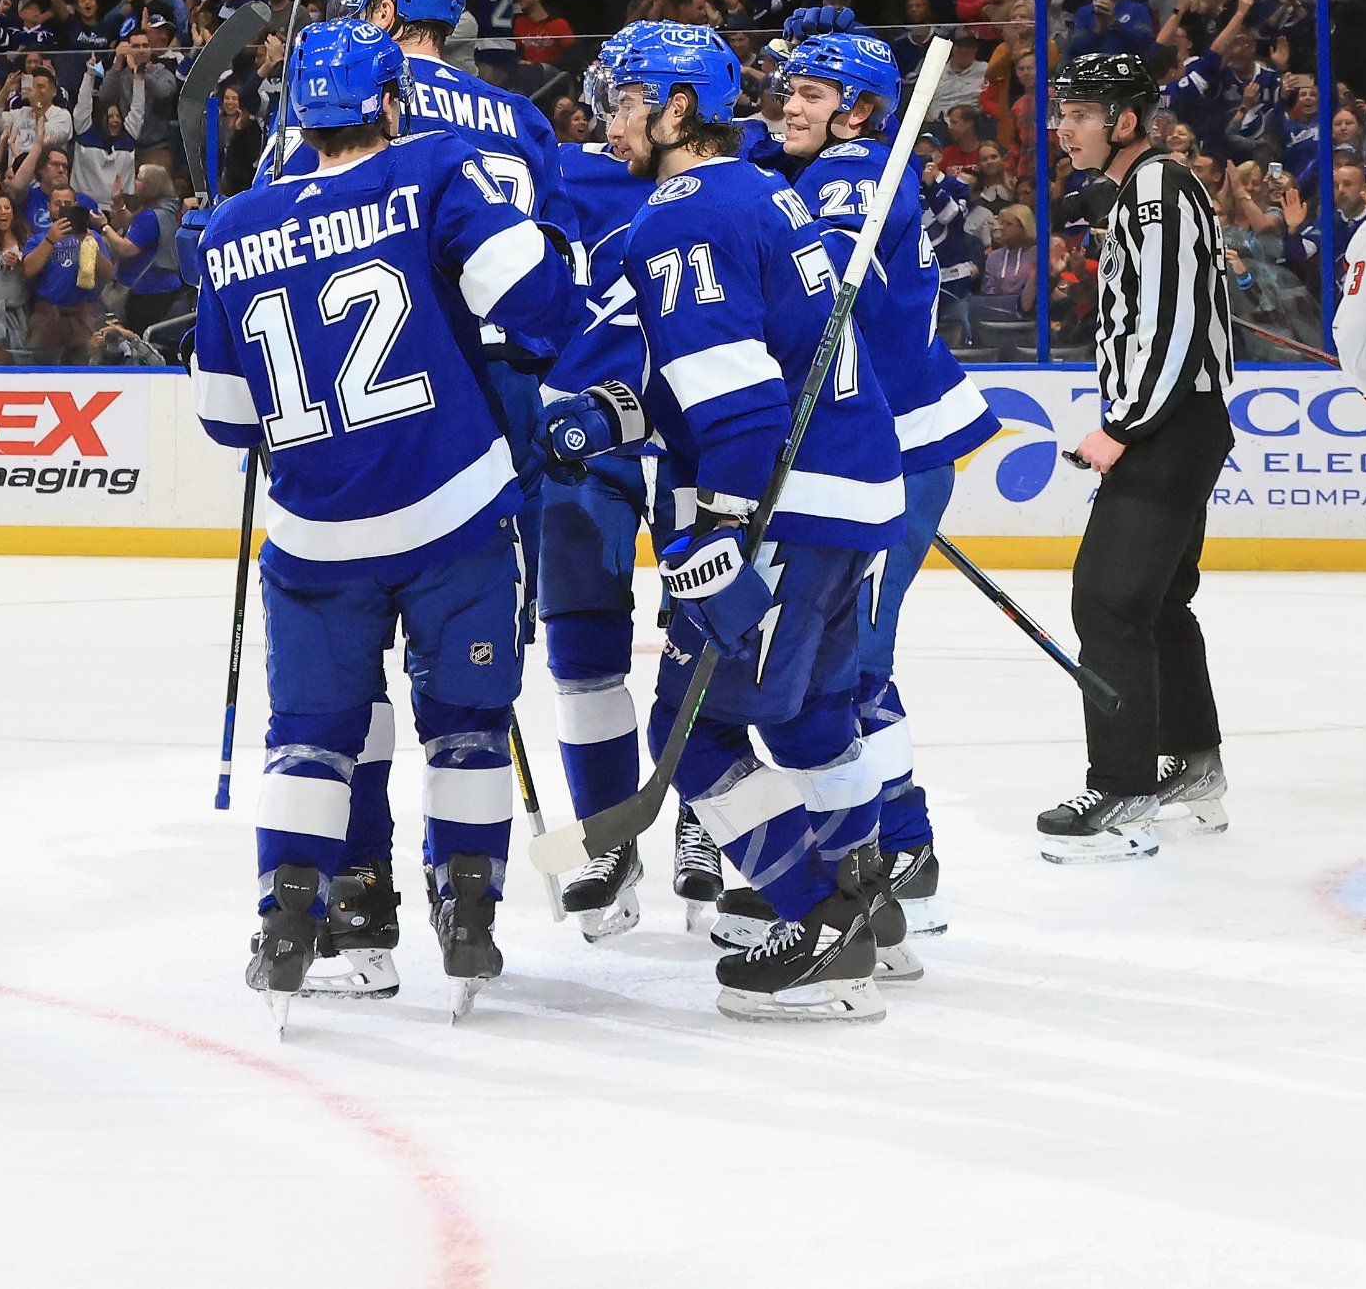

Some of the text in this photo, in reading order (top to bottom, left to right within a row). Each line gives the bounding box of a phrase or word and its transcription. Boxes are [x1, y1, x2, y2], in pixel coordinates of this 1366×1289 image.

[669, 29, 712, 49] TGH
[861, 41, 892, 62] TGH
[308, 78, 329, 97] 12
[819, 180, 879, 217] 21
[1137, 202, 1163, 224] 93
[206, 184, 420, 292] BARRÉ-BOULET
[645, 243, 726, 318] 71
[1347, 260, 1366, 296] 3
[241, 258, 436, 452] 12
[666, 551, 733, 593] RRIOR
